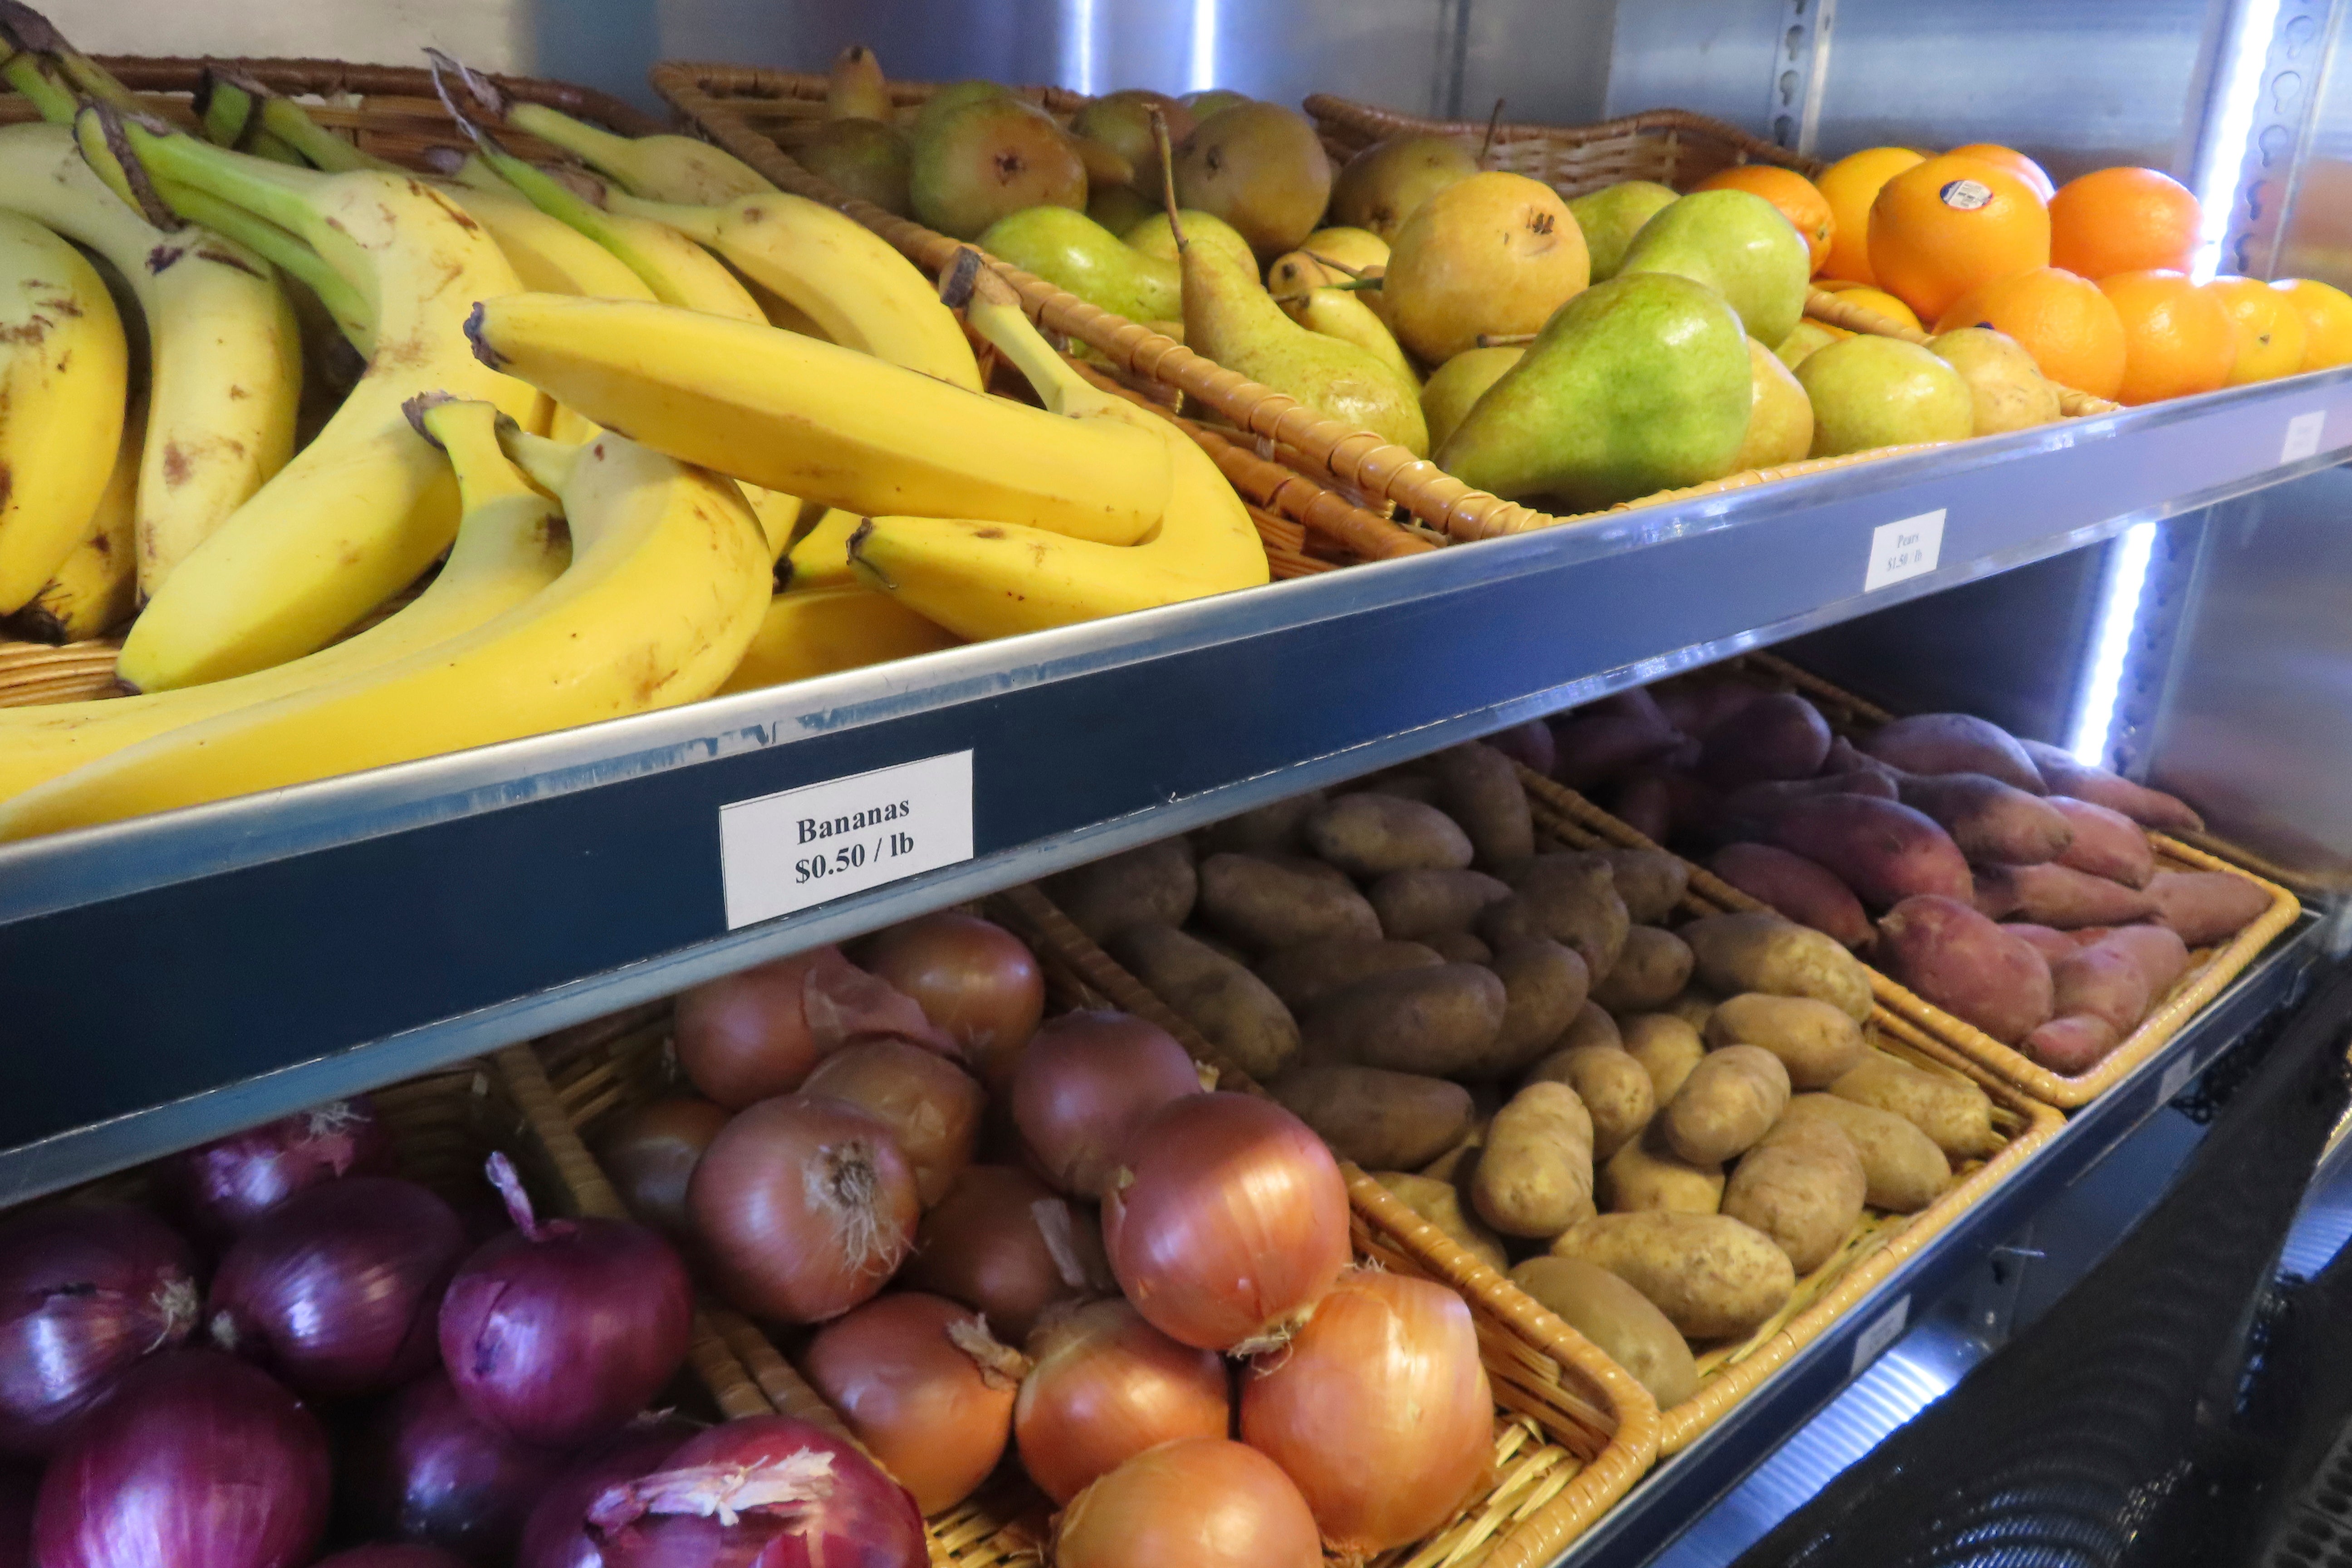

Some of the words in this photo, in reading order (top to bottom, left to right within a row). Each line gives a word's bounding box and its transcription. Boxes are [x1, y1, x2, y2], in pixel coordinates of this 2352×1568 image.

[1897, 533, 1919, 548] Pears
[795, 799, 910, 844] Bananas
[795, 843, 865, 884] $0.50
[874, 838, 882, 862] /
[890, 832, 914, 857] lb
